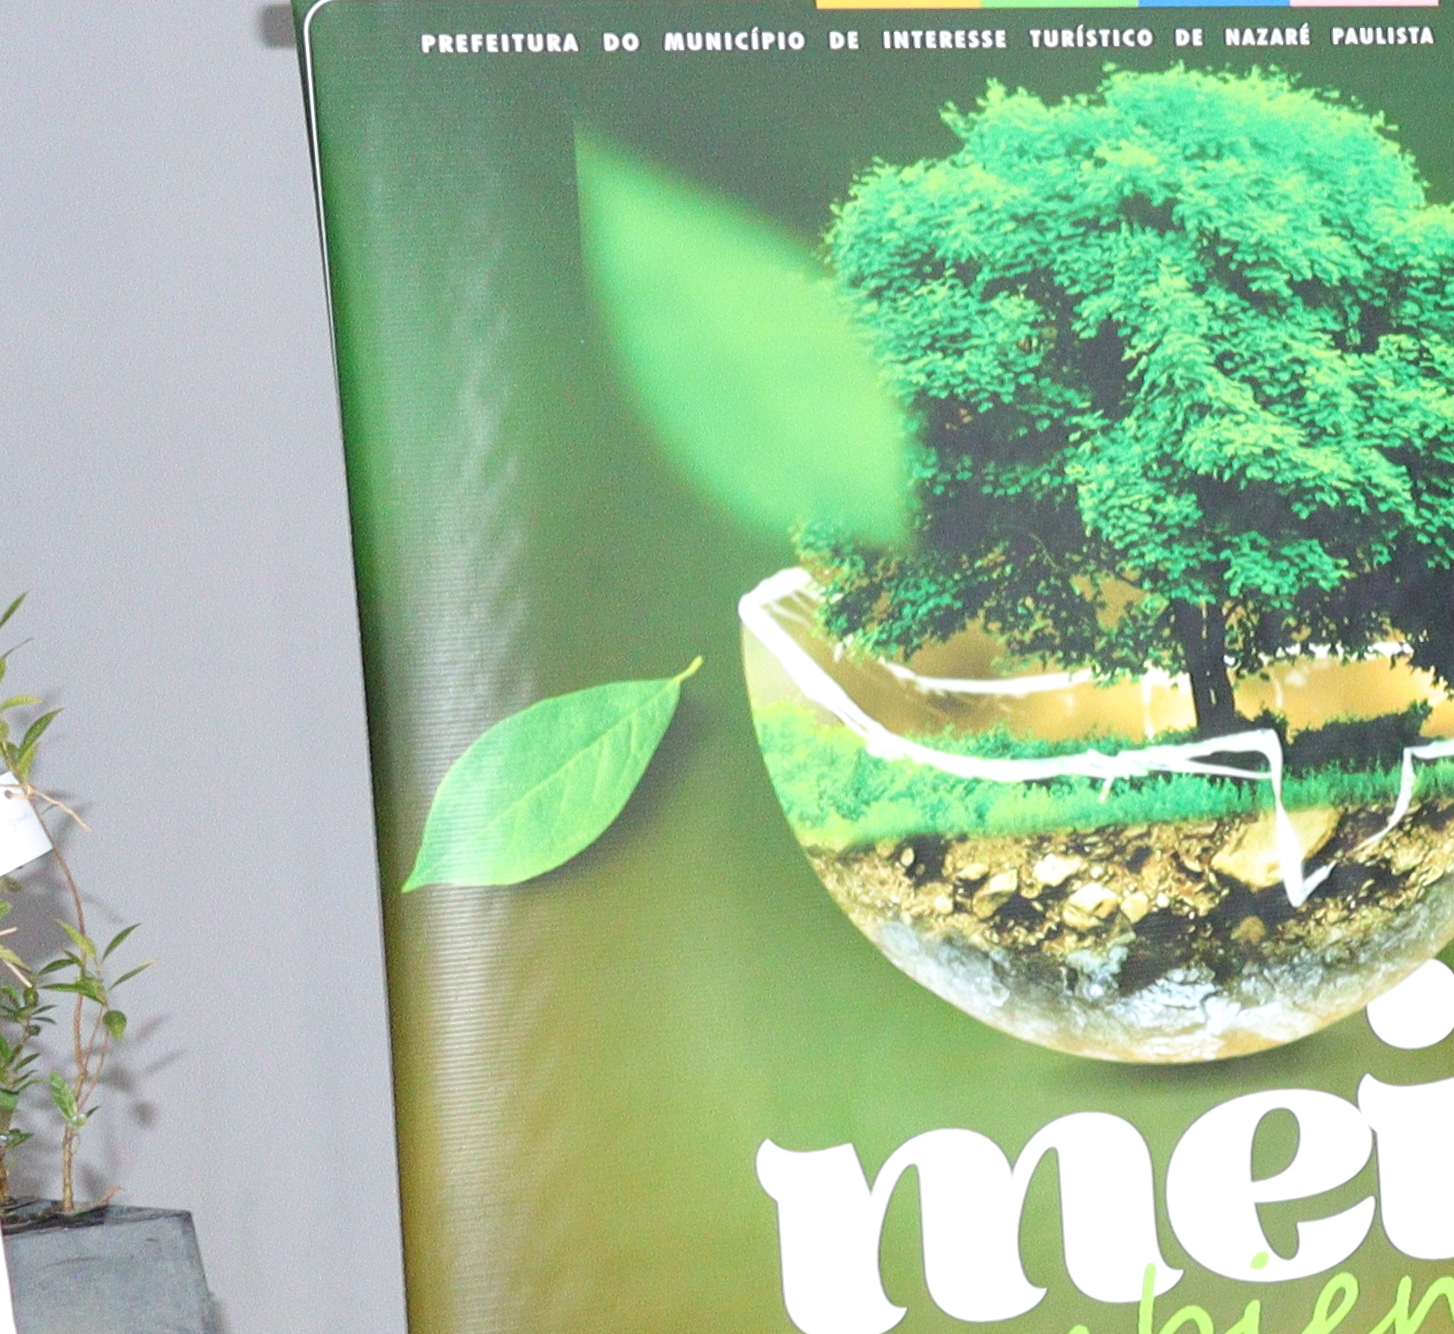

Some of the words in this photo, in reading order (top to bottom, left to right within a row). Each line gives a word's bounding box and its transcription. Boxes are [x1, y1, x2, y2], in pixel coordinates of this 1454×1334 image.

[421, 33, 579, 54] PREFEITURA
[603, 32, 640, 52] DO
[664, 26, 806, 52] MUNICÍPIO
[829, 31, 859, 50] DE
[883, 29, 1007, 49] INTERESSE
[1029, 24, 1154, 49] TURÍSTICO
[1175, 28, 1204, 48] DE
[1224, 22, 1311, 47] NAZARÉ
[1332, 25, 1435, 46] PAULISTA
